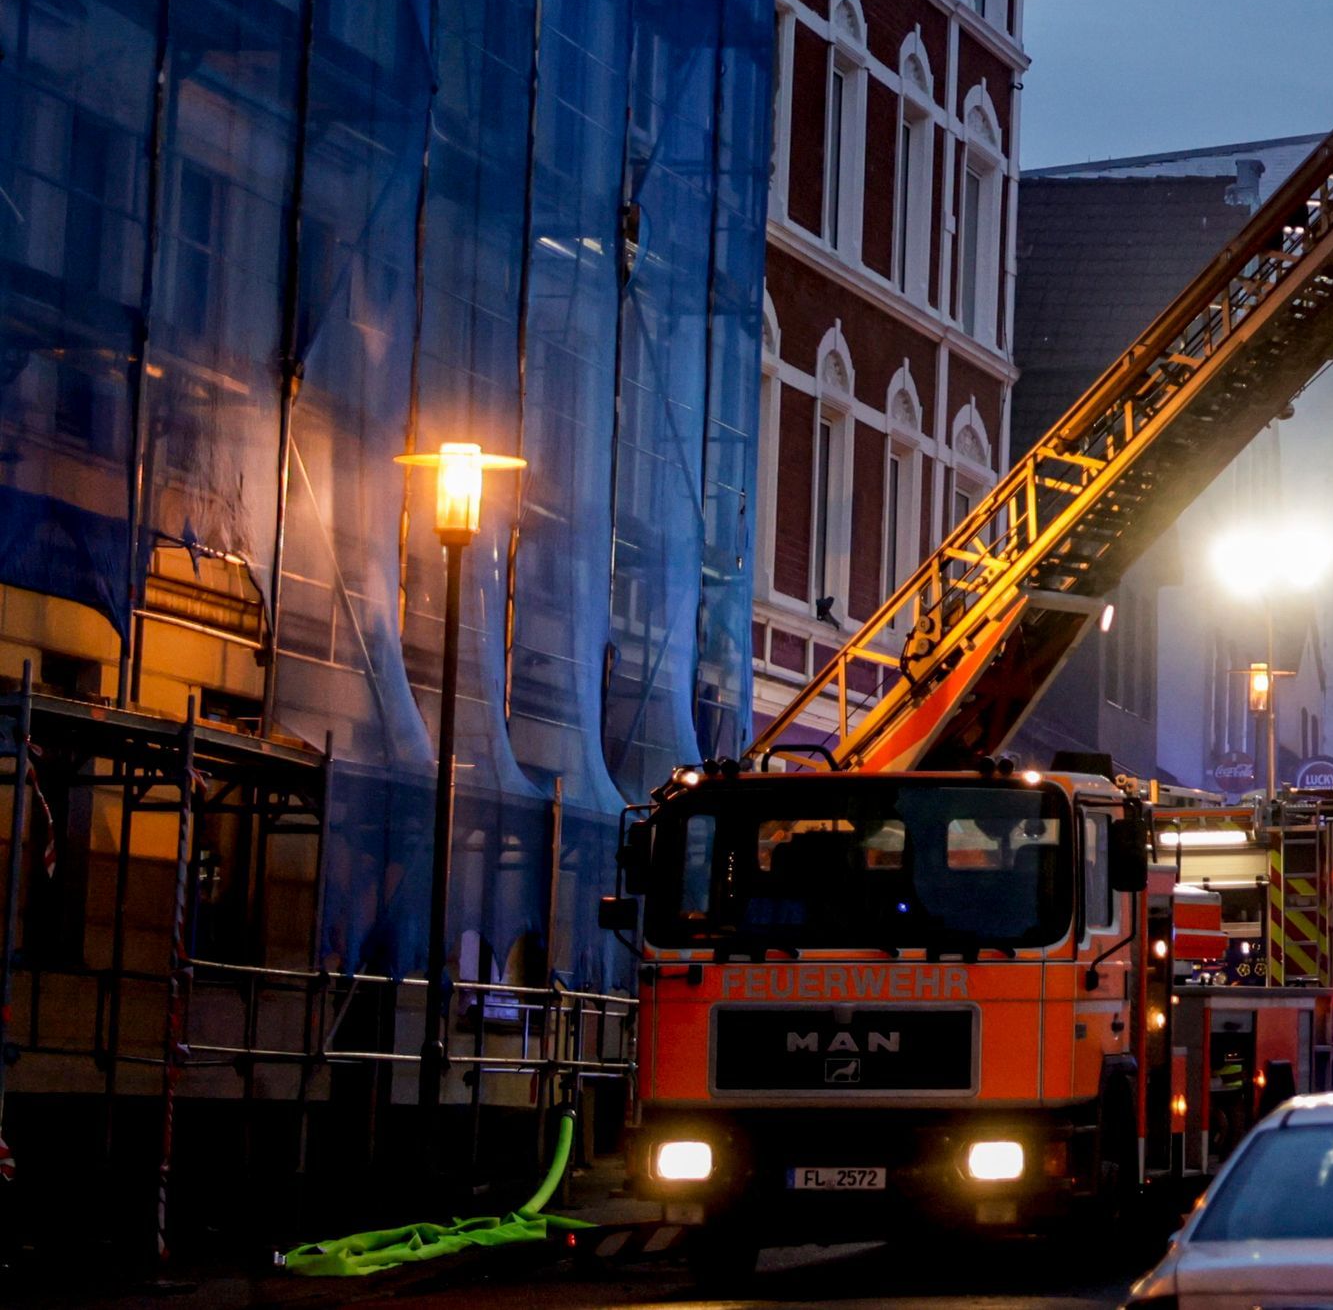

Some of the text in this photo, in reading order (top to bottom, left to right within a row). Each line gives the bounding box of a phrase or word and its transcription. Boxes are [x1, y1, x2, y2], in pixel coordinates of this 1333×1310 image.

[722, 967, 969, 999] FEUERWEHR
[786, 1031, 900, 1053] MAN
[804, 1170, 878, 1188] FL 2572
